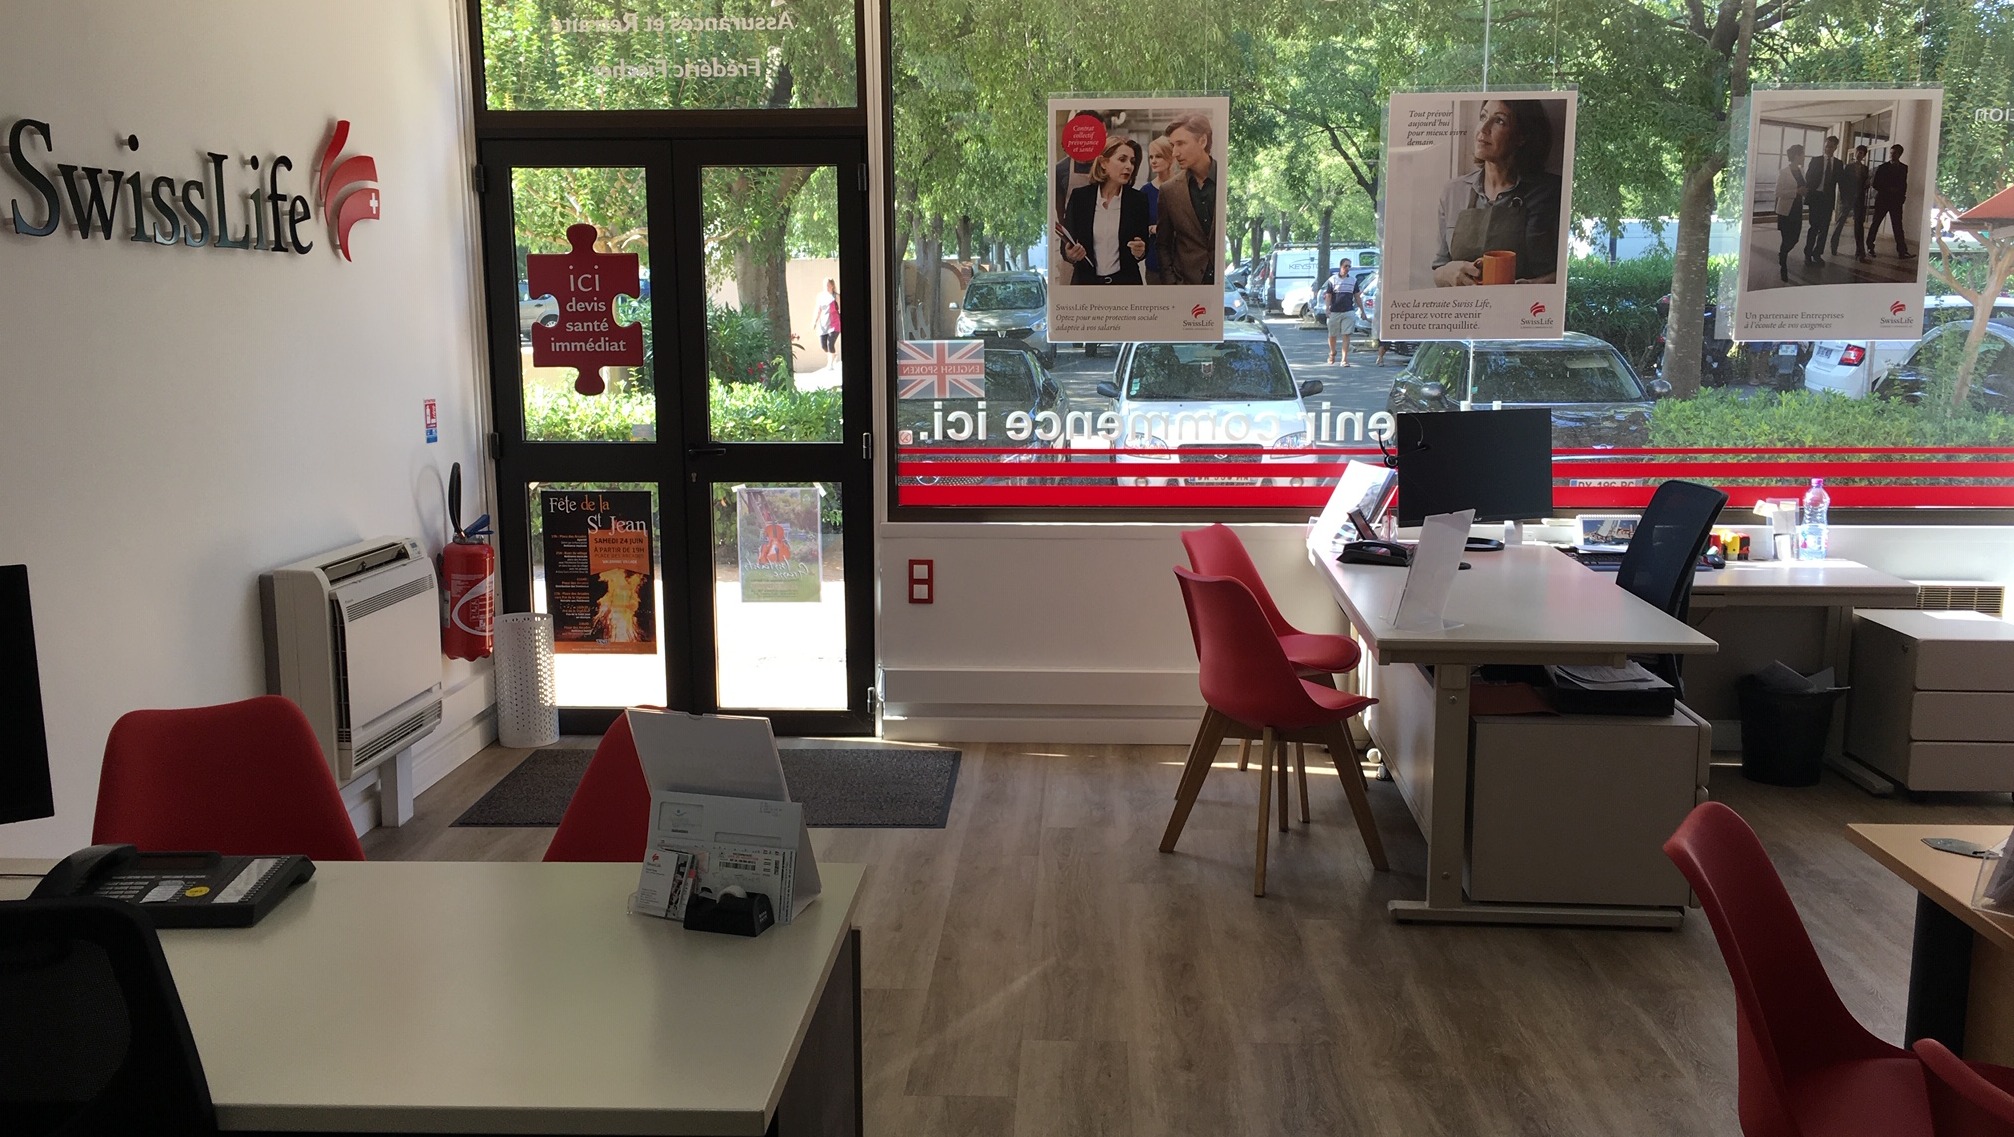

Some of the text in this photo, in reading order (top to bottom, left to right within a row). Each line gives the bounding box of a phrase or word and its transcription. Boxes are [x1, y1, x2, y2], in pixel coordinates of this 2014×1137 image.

[8, 118, 314, 255] SwissLife
[569, 265, 600, 292] ici
[566, 297, 606, 312] devis
[1130, 304, 1170, 313] Entreprises
[1390, 299, 1492, 310] Avec la retraite Swiss Life,
[1390, 311, 1428, 321] préparez
[1454, 311, 1482, 319] avenir
[1520, 317, 1554, 325] SwissLife
[1745, 312, 1844, 321] Un partenaire Entreprises
[1880, 316, 1914, 324] SwissLife
[565, 317, 609, 332] santé
[1182, 319, 1214, 327] SwissLife
[1402, 322, 1426, 330] toute
[1428, 321, 1480, 332] tranquillité.
[551, 337, 627, 352] immédiat
[550, 495, 610, 514] Fête de la
[587, 513, 647, 537] St Jean
